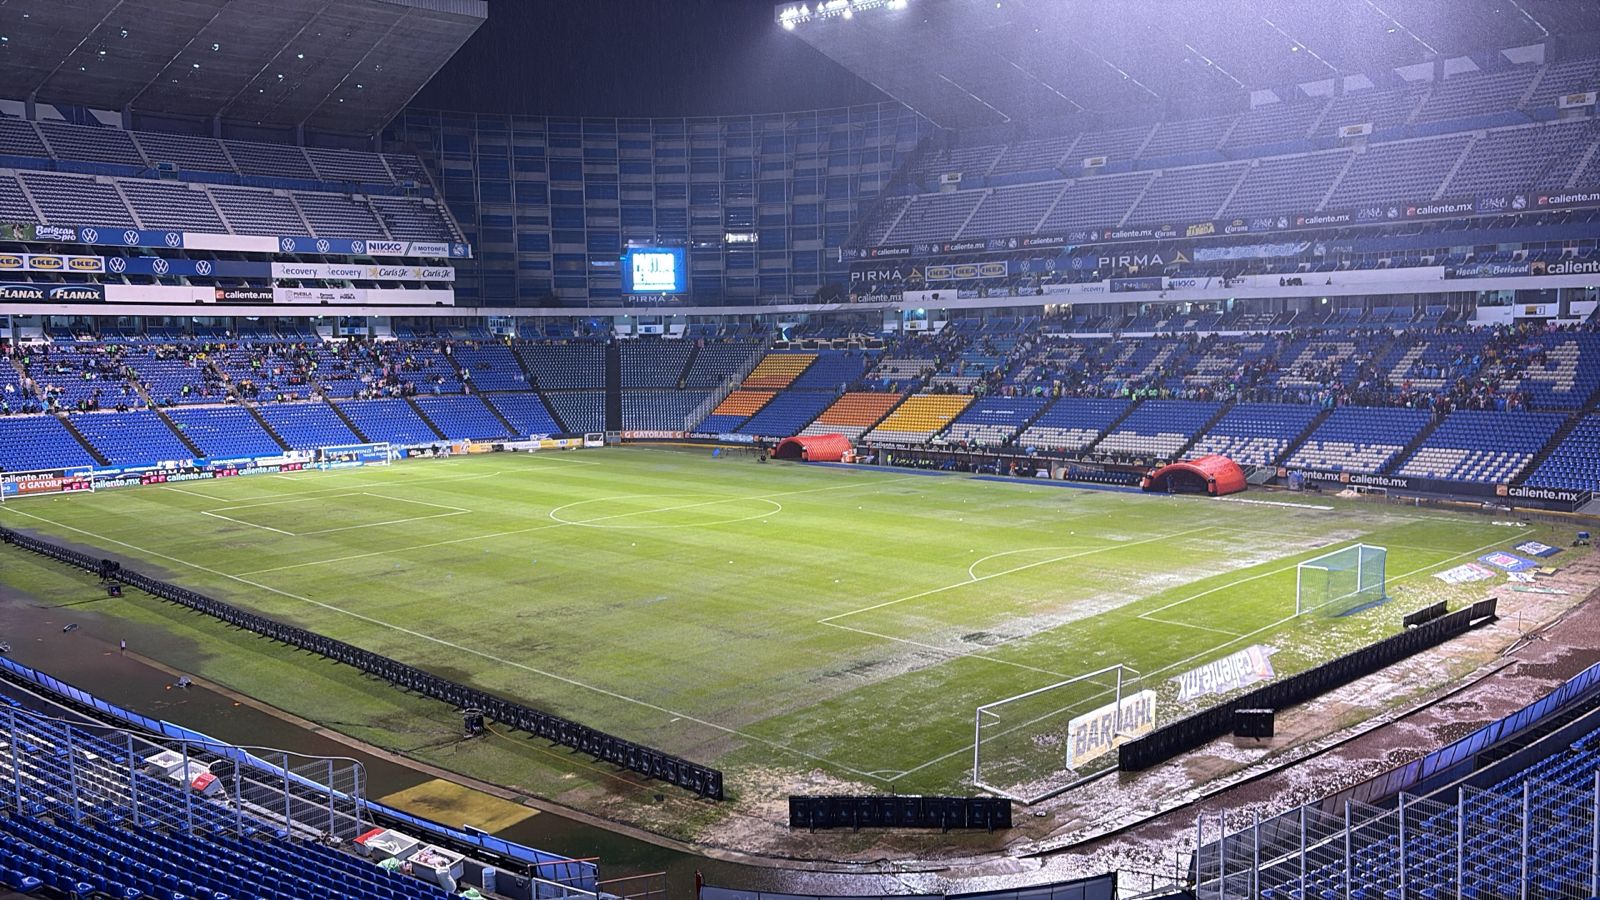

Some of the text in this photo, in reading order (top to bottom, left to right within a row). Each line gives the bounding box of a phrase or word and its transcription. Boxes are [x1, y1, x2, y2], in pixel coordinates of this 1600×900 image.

[1416, 204, 1472, 215] caliente.mx
[1305, 214, 1349, 224] caliente.mx
[1111, 230, 1152, 239] caliente.mx
[1098, 254, 1164, 269] PIRMA
[850, 268, 902, 283] PIRMA
[56, 289, 100, 299] FLANAX
[225, 291, 273, 299] caliente.mx
[858, 295, 902, 303] caliente.mx
[240, 465, 280, 475] caliente.mx
[167, 471, 213, 482] caliente.mx
[90, 478, 140, 489] caliente.mx
[1350, 476, 1408, 491] caliente.mx
[1508, 487, 1578, 502] caliente.mx
